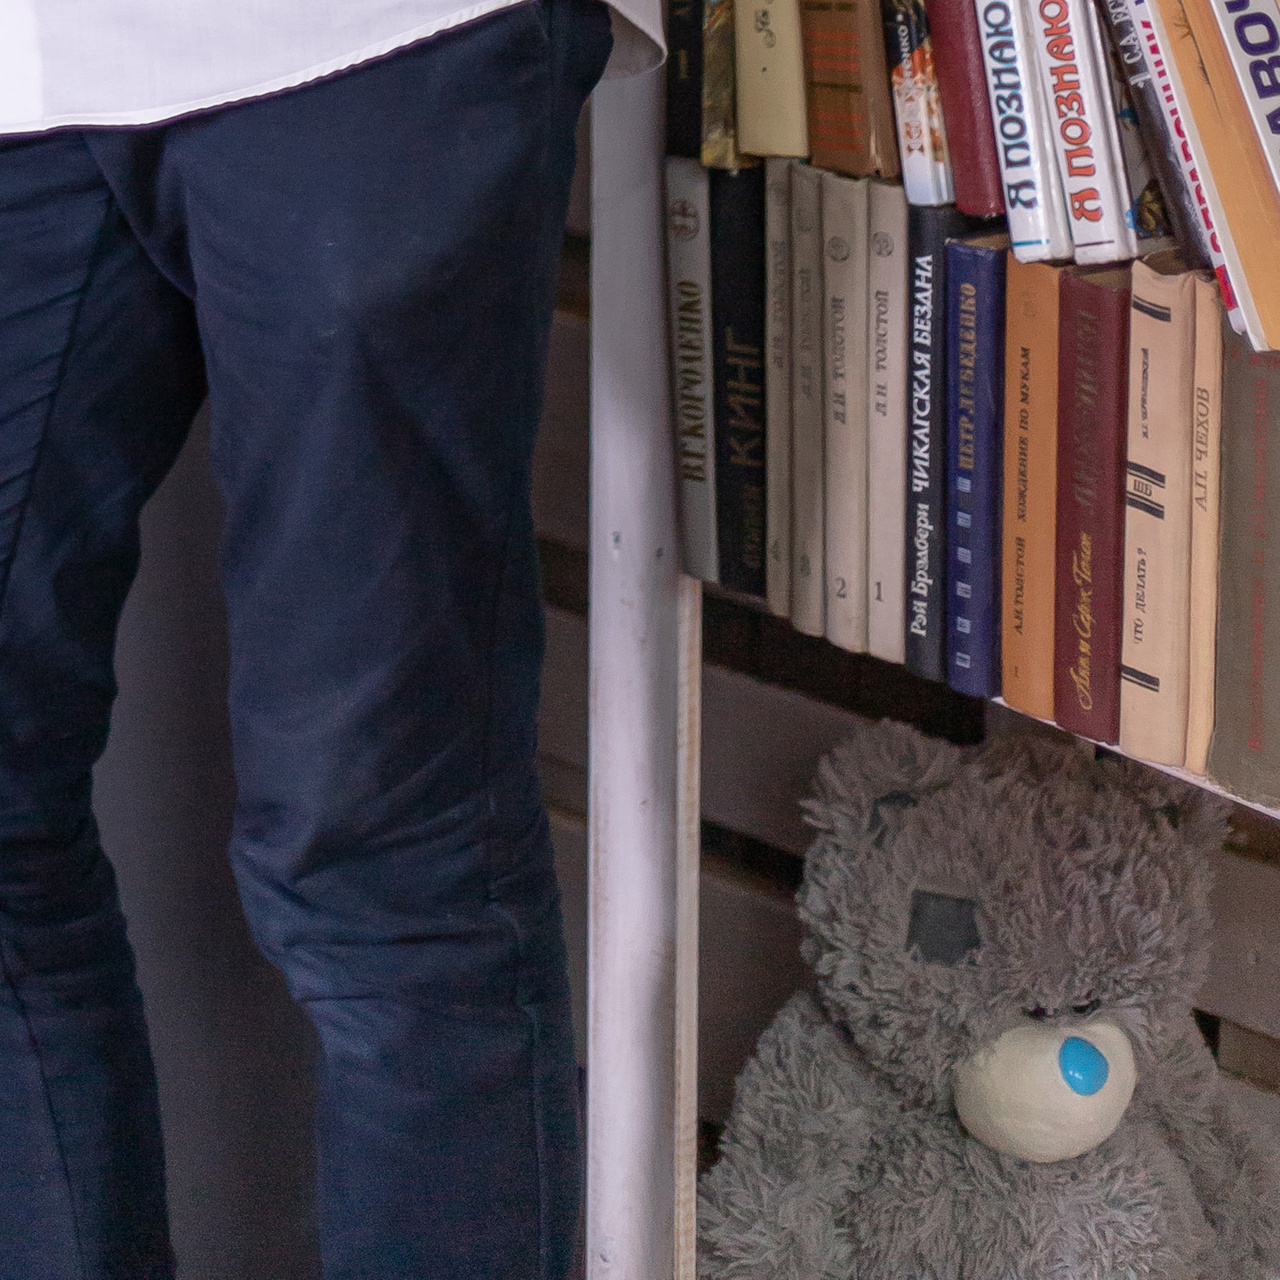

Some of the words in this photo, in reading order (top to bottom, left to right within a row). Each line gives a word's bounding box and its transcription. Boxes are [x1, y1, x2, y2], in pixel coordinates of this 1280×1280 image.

[982, 0, 1033, 168] ПОЗНАЮ
[1006, 172, 1039, 211] Я
[1070, 185, 1103, 223] Я
[914, 253, 934, 346] БЕЗДНА
[873, 290, 889, 372] ТОЛСТОЙ
[957, 282, 977, 414] ЛЕБЕДЕНКО
[725, 325, 762, 467] КИНГ
[1018, 346, 1031, 405] МУКАМ
[912, 353, 932, 494] ЧИКАГСКАЯ
[957, 415, 975, 471] ПЕТР
[1018, 408, 1029, 431] ПО
[1195, 386, 1210, 461] ЧЕХОВ
[911, 502, 934, 597] Брэдбери
[834, 576, 848, 599] 2
[874, 580, 883, 603] 1
[910, 601, 929, 637] Рэй
[1133, 617, 1145, 645] ЧТО
